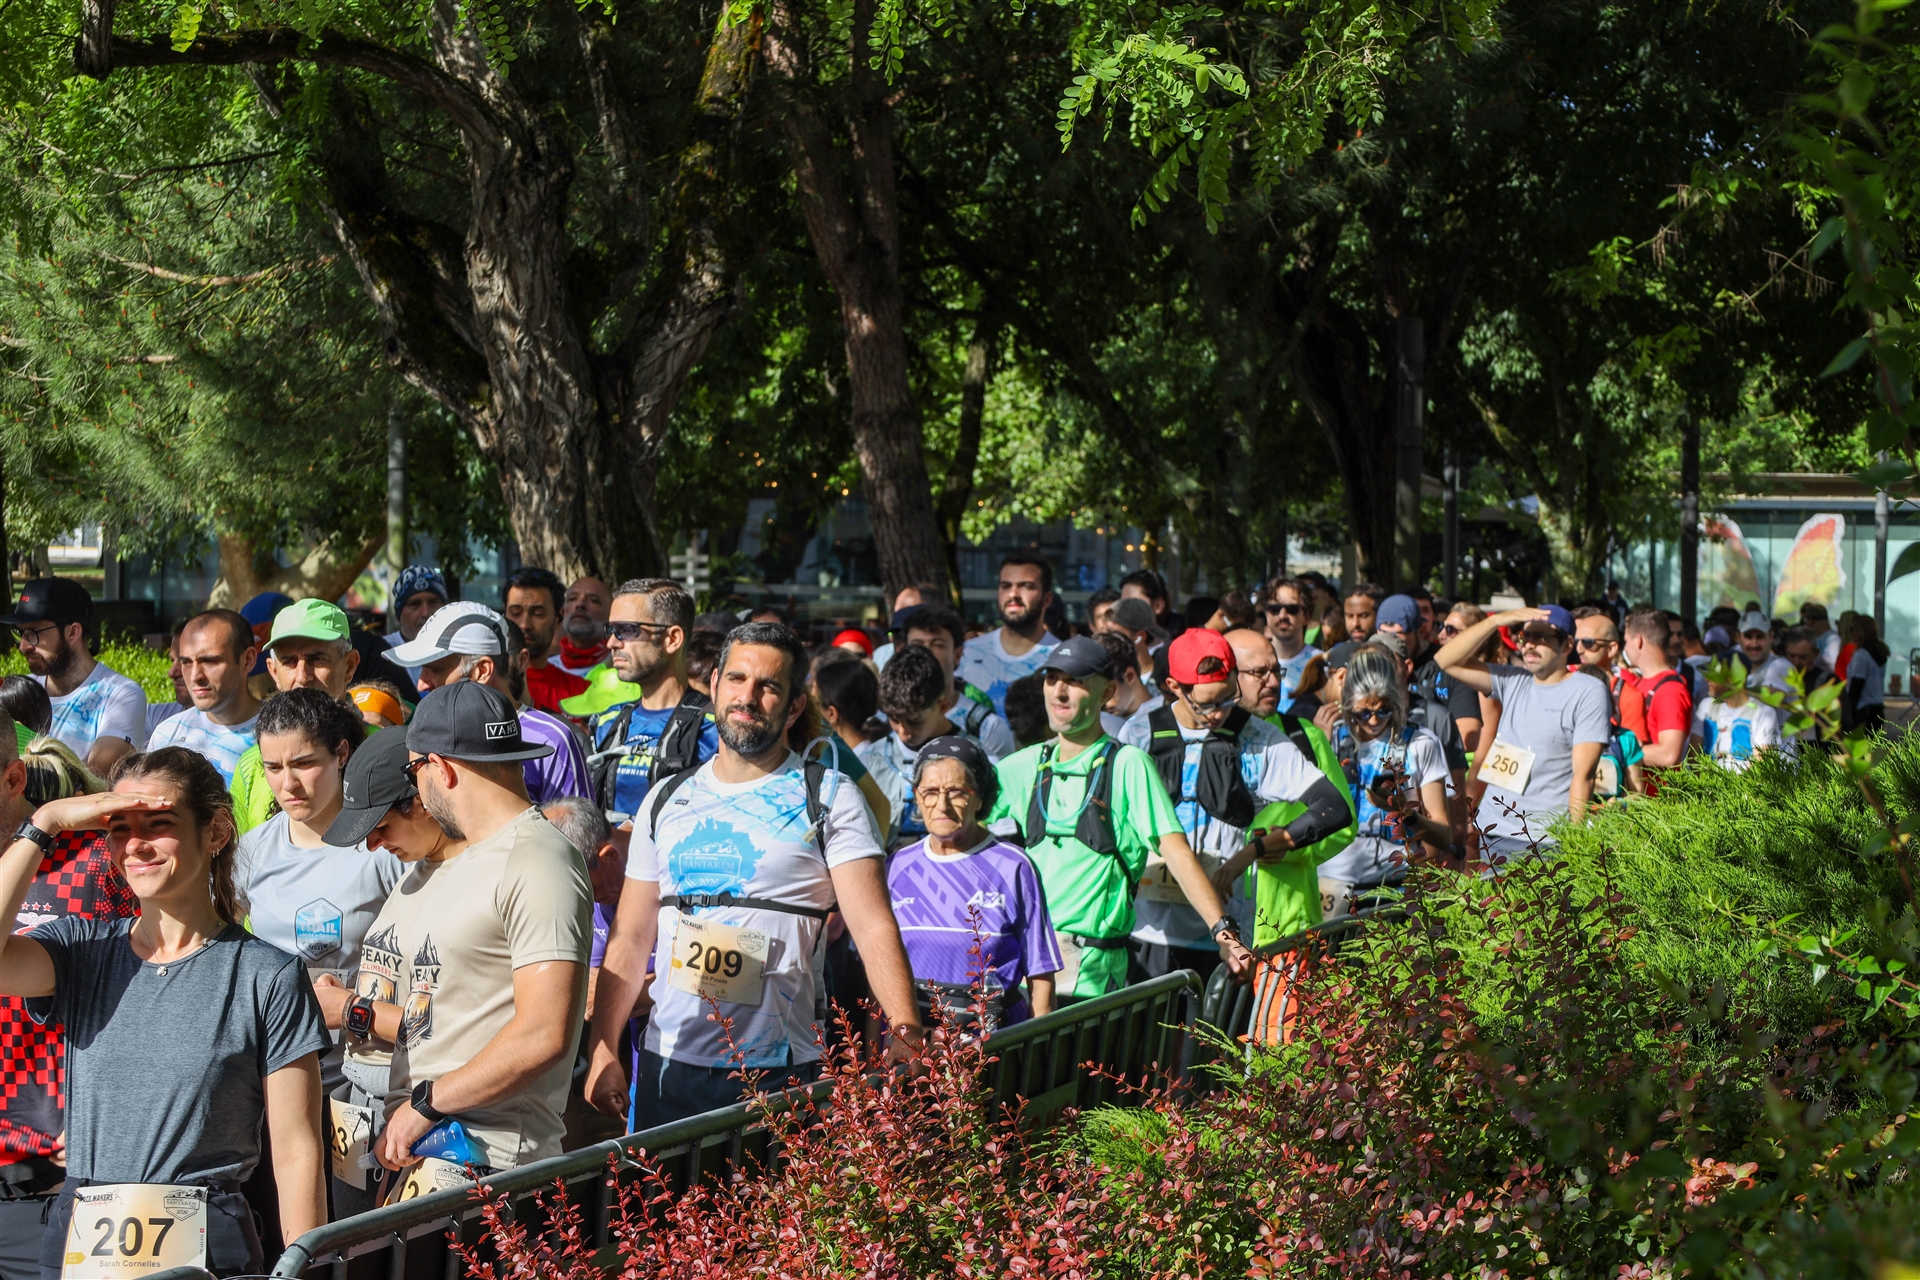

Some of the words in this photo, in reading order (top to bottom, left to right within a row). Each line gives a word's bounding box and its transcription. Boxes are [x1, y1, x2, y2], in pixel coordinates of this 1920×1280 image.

[489, 723, 516, 736] VANS
[1491, 754, 1519, 776] 250
[966, 890, 1005, 909] AZA
[299, 922, 338, 933] TRAIL
[686, 941, 743, 978] 209
[362, 963, 391, 978] CLIMBERS
[93, 1193, 113, 1202] MAKERS
[166, 1198, 197, 1206] SANTARÉM
[91, 1217, 174, 1257] 207
